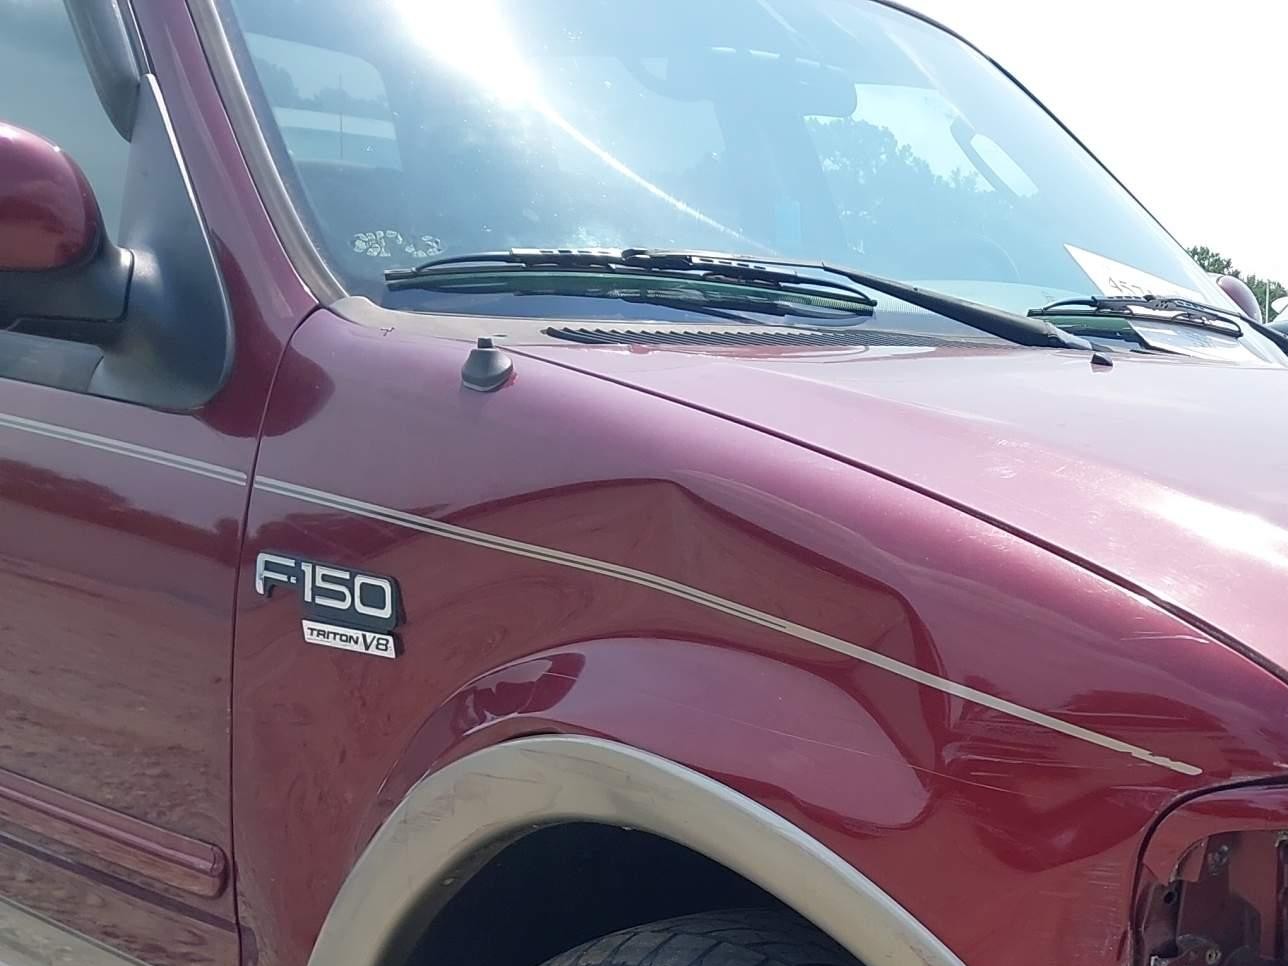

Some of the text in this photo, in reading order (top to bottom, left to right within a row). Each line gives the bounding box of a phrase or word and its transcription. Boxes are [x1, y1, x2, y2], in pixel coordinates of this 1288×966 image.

[255, 552, 393, 619] F-150
[306, 626, 390, 652] TRITON V8
